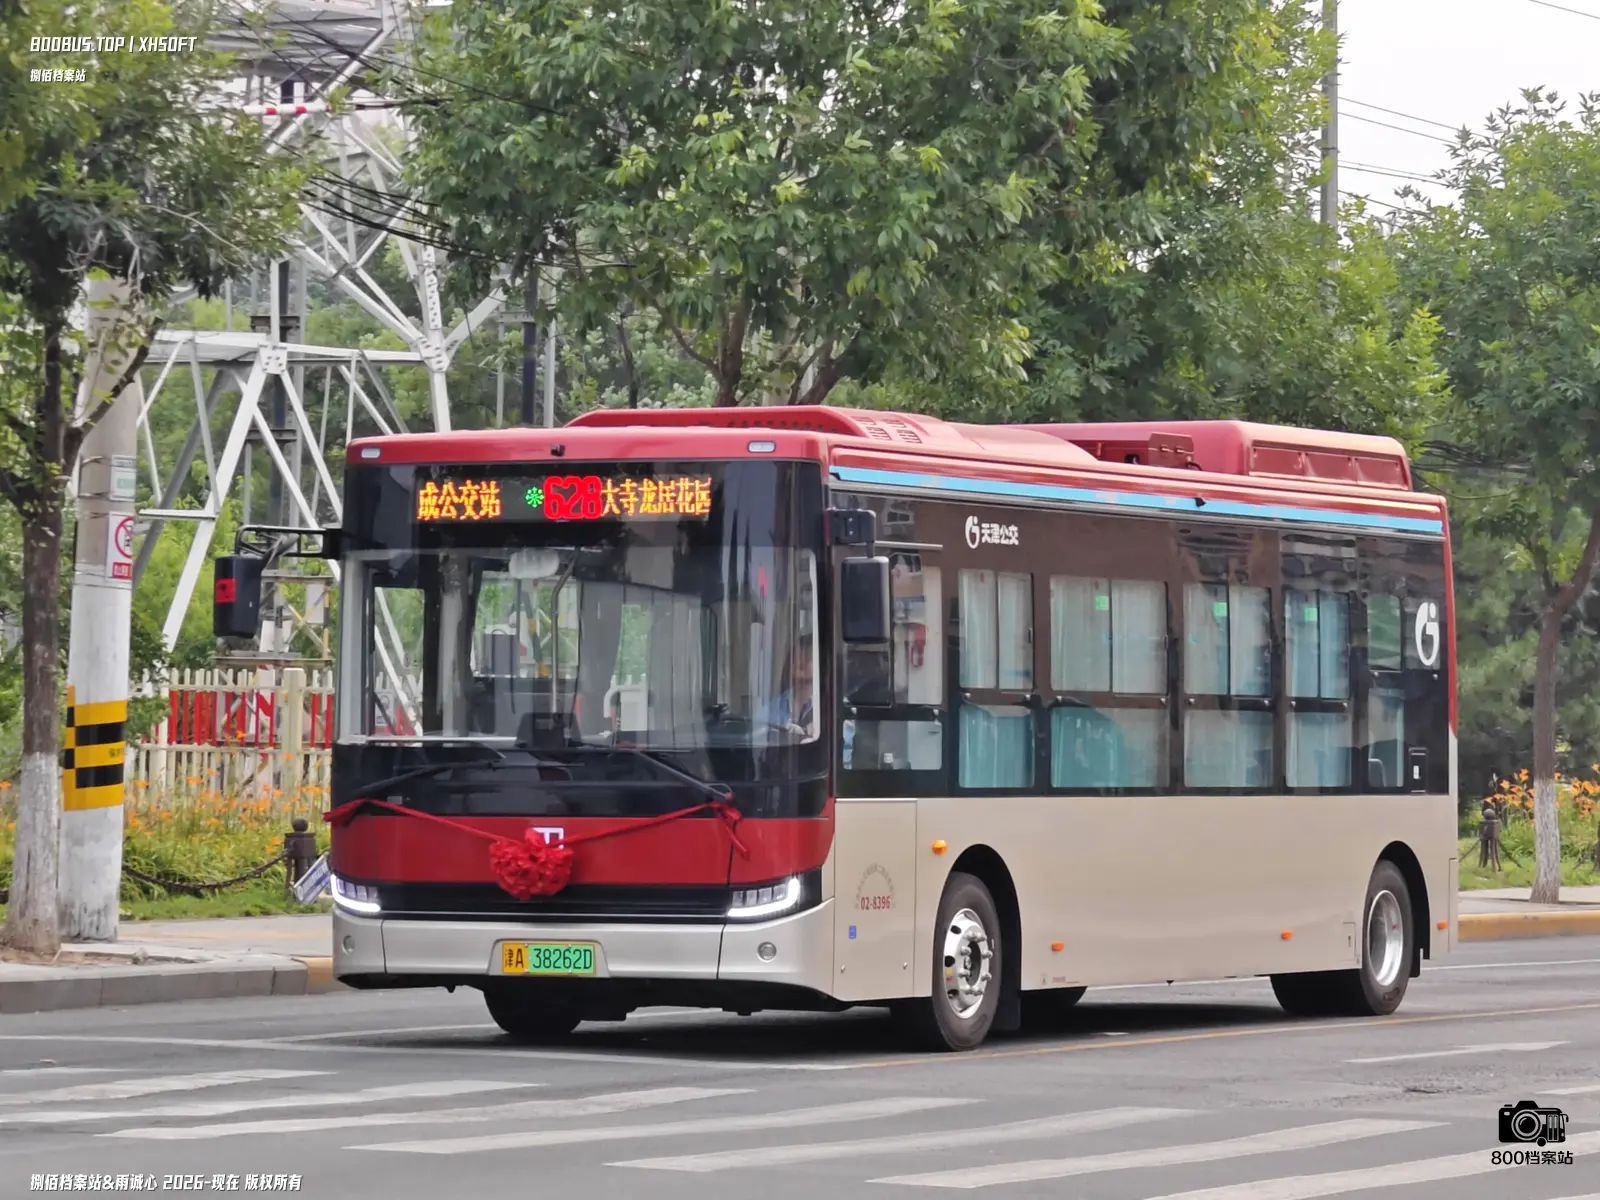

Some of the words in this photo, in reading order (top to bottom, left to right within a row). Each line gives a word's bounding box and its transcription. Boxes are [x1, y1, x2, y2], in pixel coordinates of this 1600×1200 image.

[543, 475, 603, 520] 628
[981, 522, 1020, 546] 天津公交
[860, 895, 891, 910] 02-8396
[532, 947, 593, 970] 38262D
